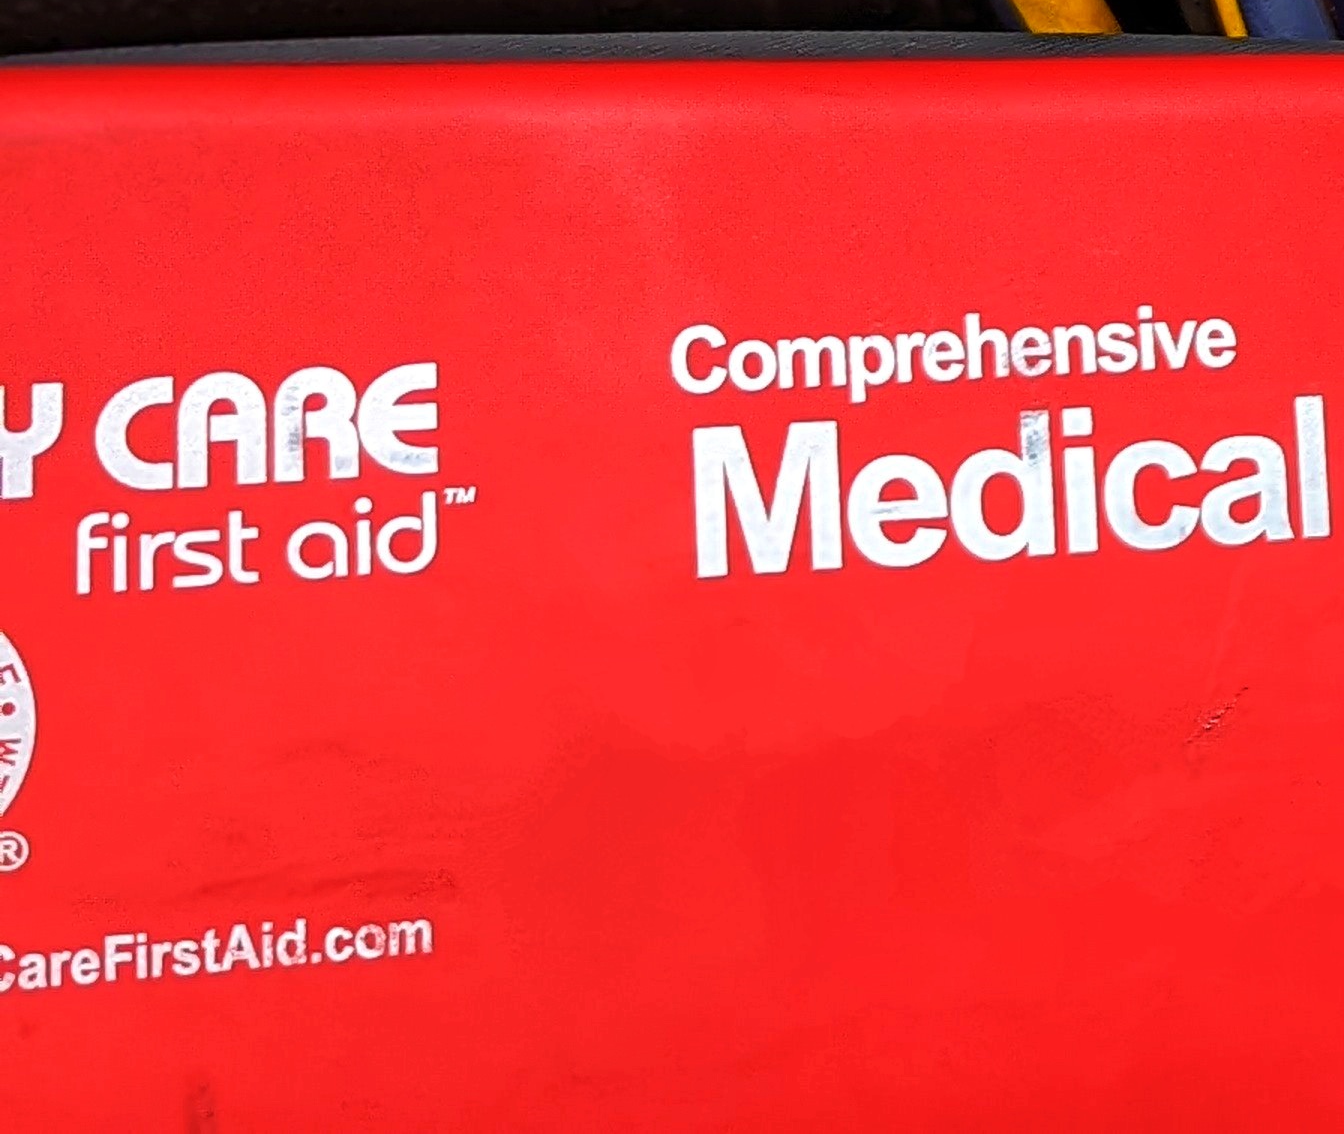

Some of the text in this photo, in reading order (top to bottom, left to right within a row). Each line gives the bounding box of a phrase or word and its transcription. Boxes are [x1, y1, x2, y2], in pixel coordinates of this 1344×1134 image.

[670, 305, 1237, 403] Comprehensive
[95, 362, 438, 490] CARE
[689, 394, 1331, 579] Medical
[76, 511, 260, 594] first
